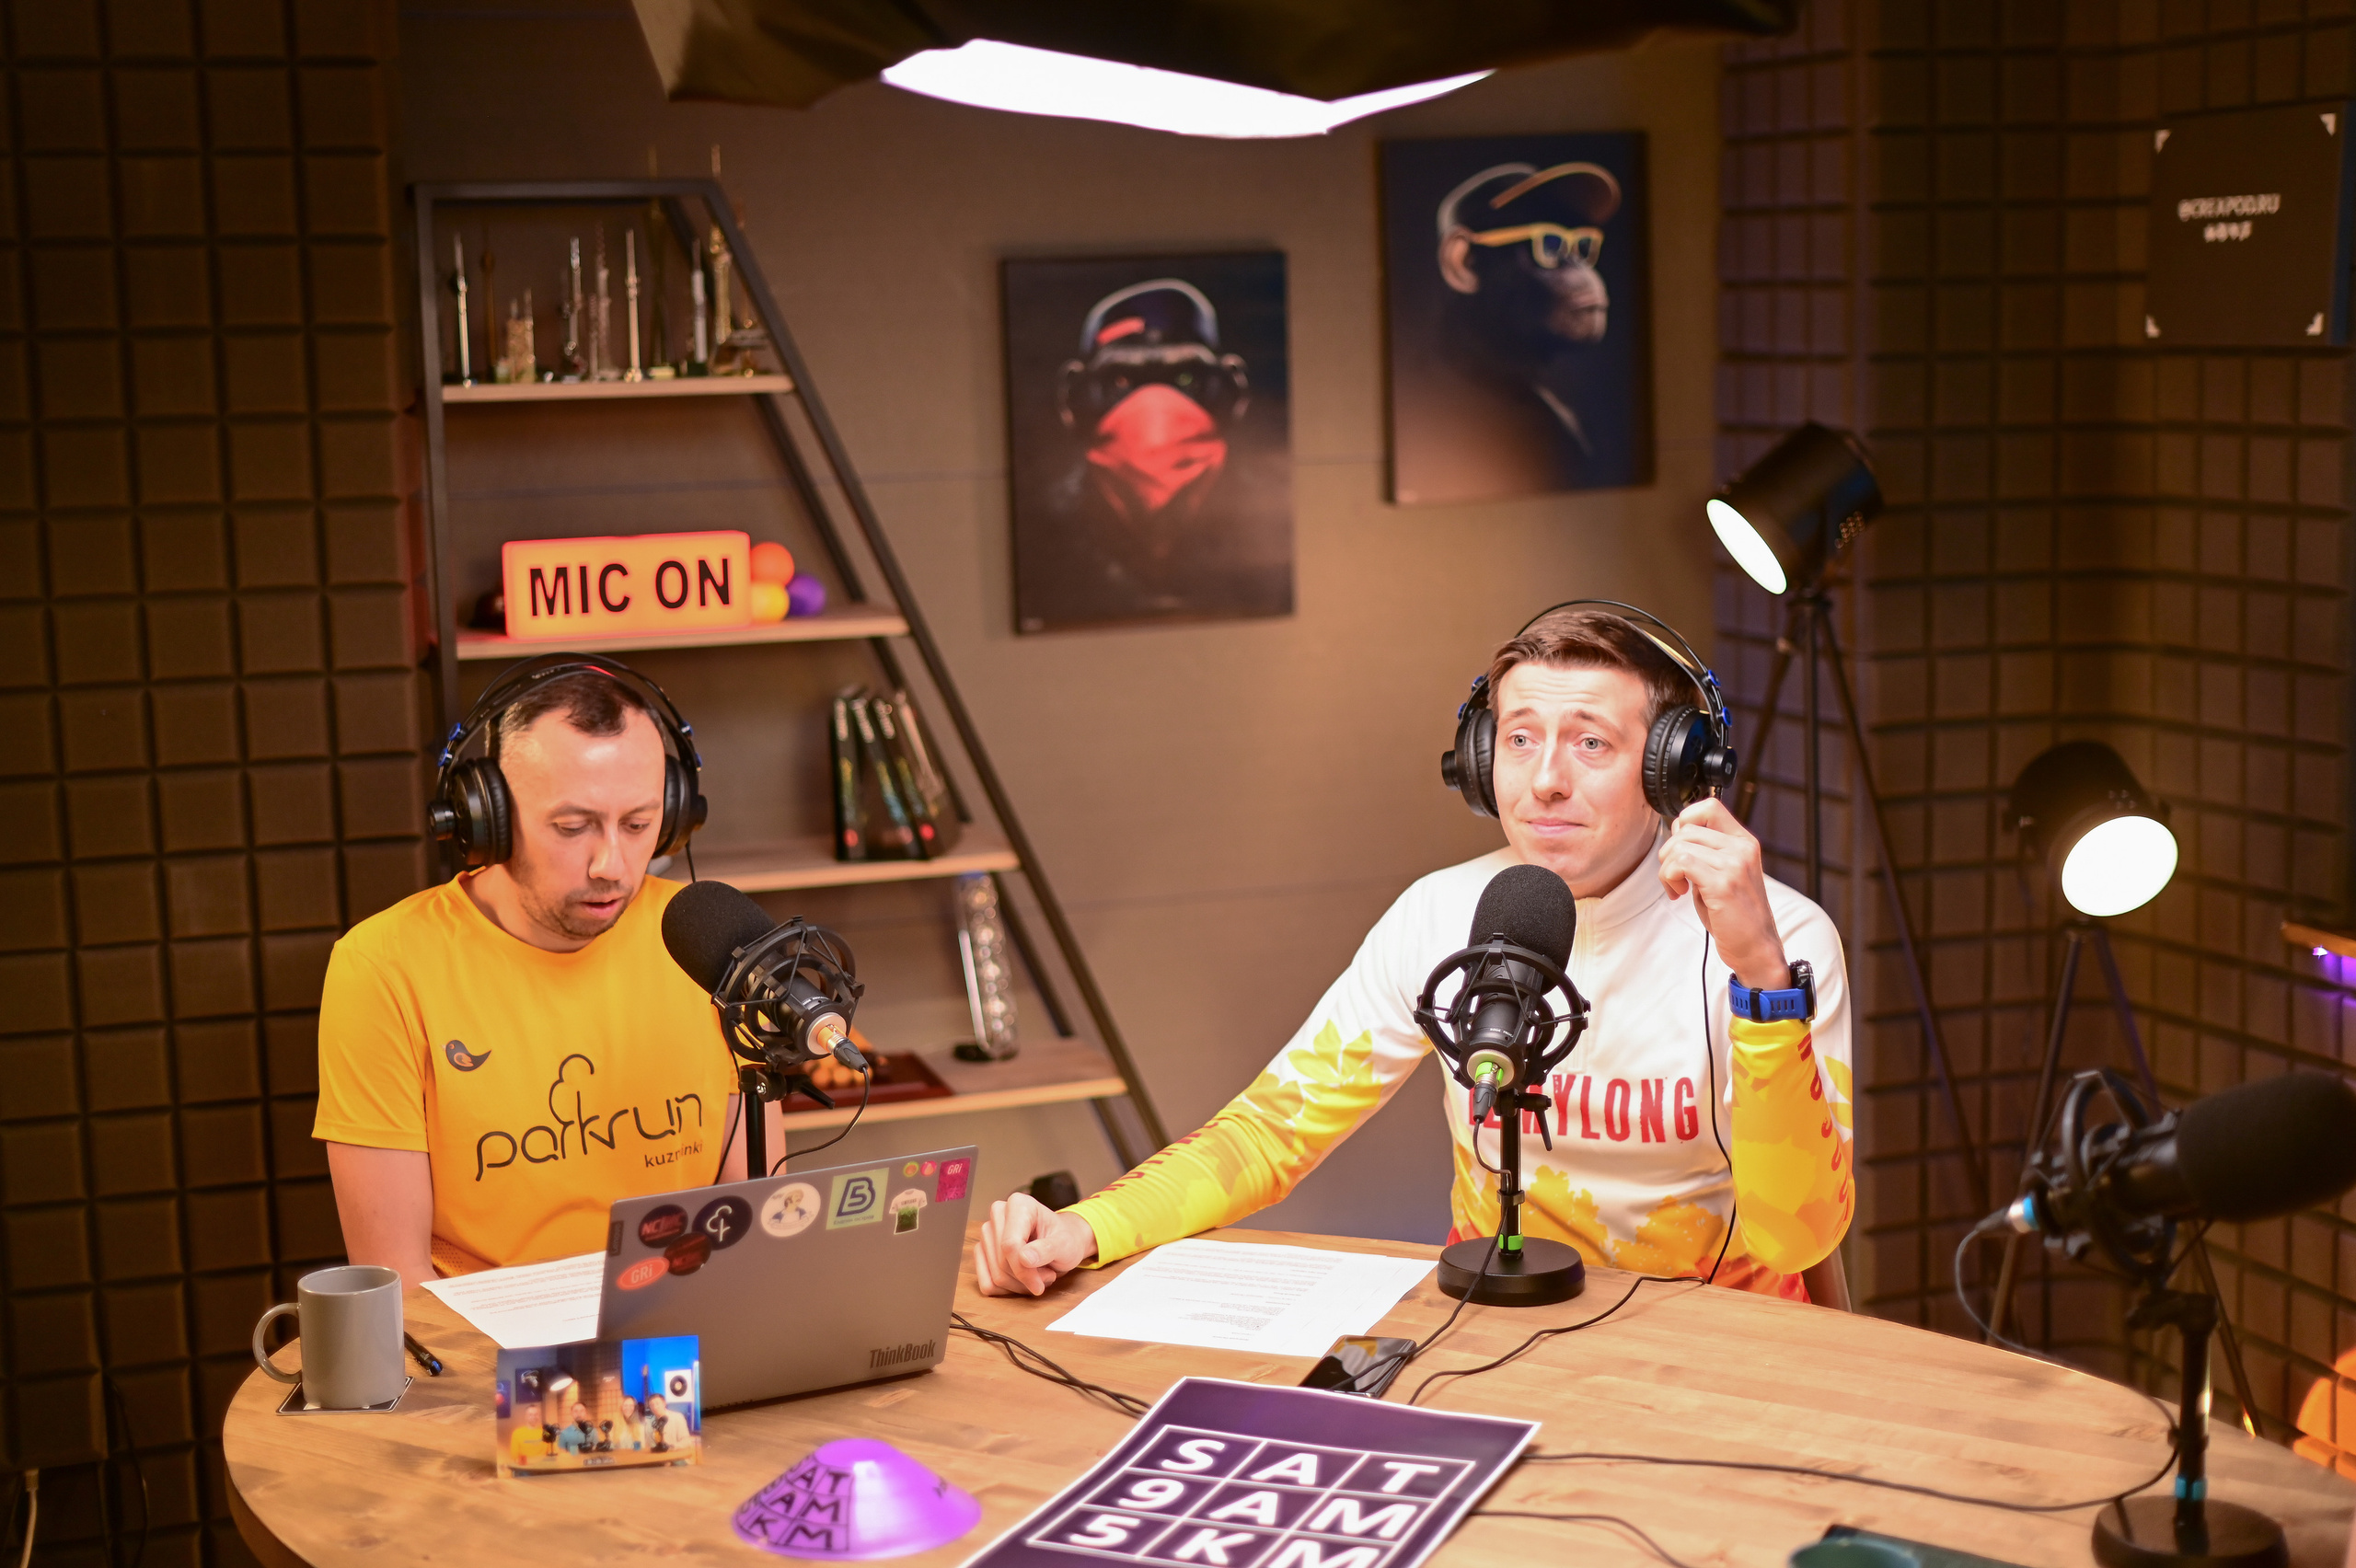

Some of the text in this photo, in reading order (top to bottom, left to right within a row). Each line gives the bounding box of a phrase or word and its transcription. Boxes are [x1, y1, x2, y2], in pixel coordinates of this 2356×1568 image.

[530, 559, 730, 617] MIC ON
[475, 1054, 702, 1182] parkrun
[1469, 1073, 1700, 1143] YLONG
[630, 1264, 653, 1285] GRi
[870, 1339, 936, 1369] ThinkBook
